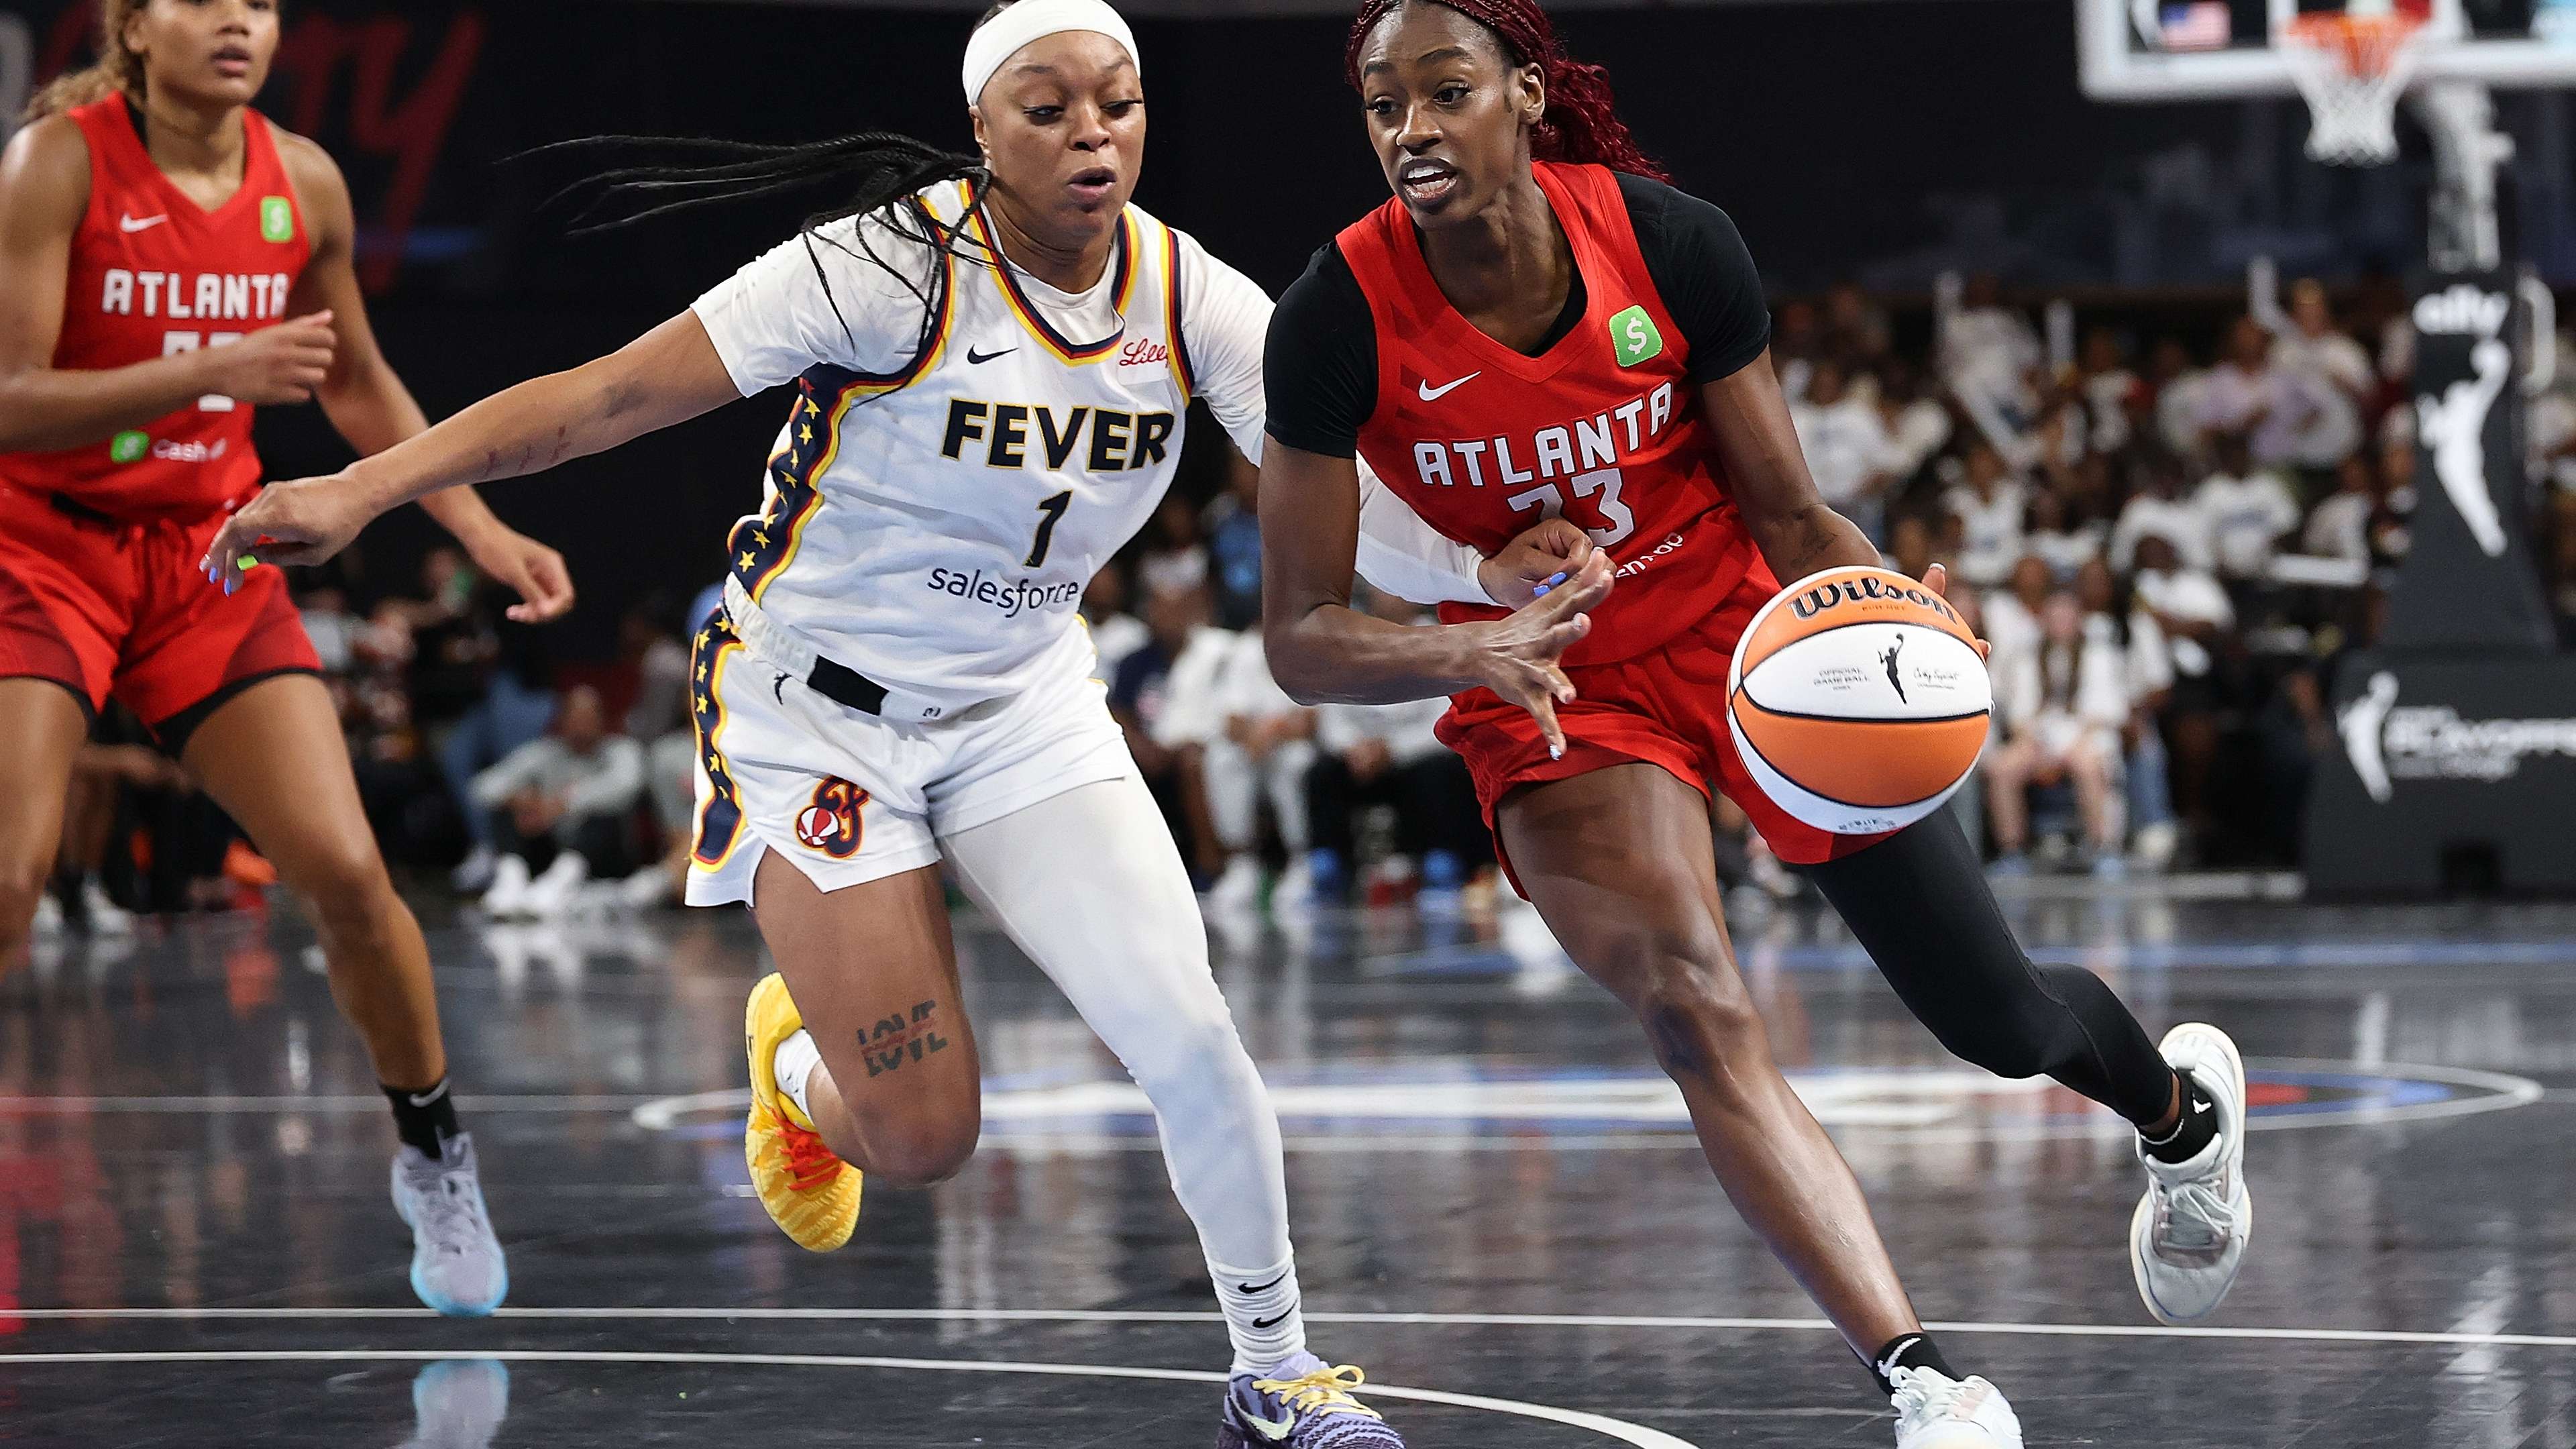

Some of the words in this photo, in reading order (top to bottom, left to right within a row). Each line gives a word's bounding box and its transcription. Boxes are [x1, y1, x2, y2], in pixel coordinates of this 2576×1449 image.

[101, 268, 289, 319] ATLANTA
[939, 396, 1175, 472] FEVER
[1413, 381, 1673, 487] ATLANTA
[1022, 488, 1074, 568] 1
[926, 567, 1079, 618] salesforce
[1787, 578, 1957, 625] Wilson
[857, 1000, 948, 1077] LOVE
